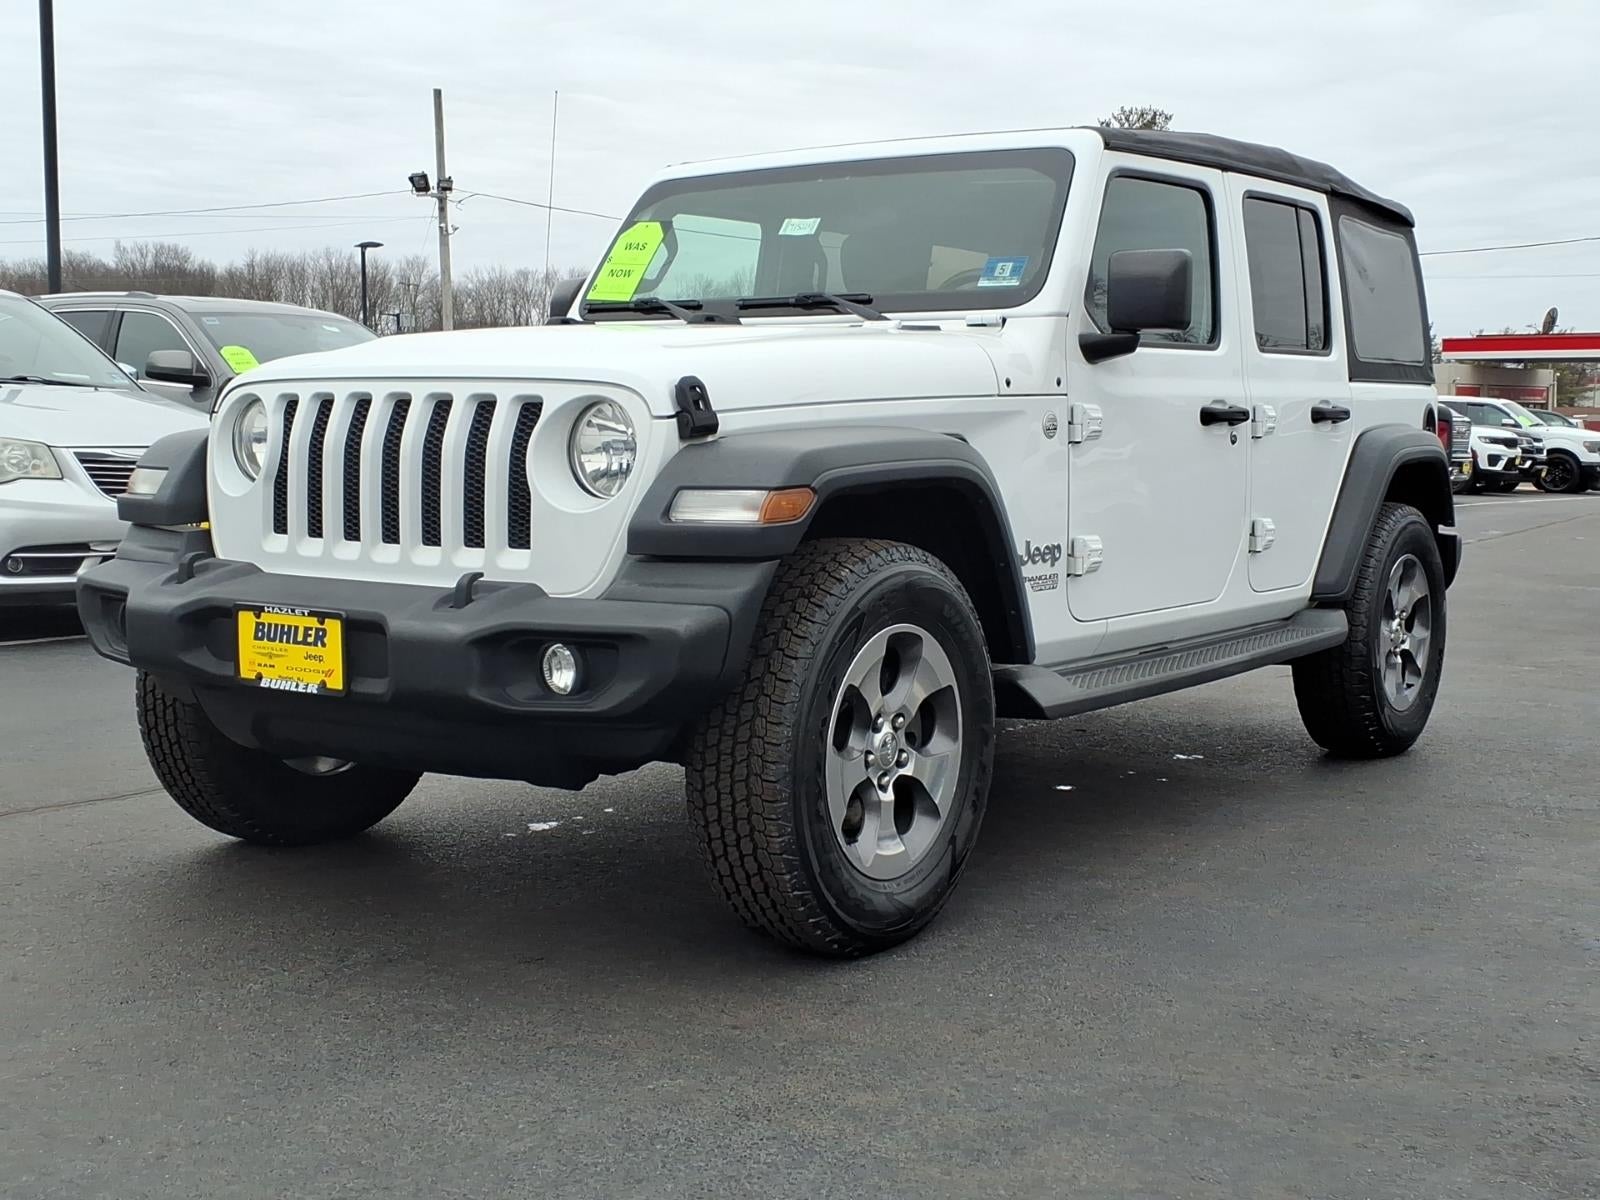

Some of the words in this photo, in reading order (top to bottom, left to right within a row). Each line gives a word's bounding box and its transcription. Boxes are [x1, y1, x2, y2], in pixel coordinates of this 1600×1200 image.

[624, 242, 648, 251] WAS
[607, 268, 634, 278] NOW
[999, 264, 1007, 275] 5
[1017, 539, 1062, 567] Jeep
[1023, 573, 1058, 583] RANGLER
[264, 606, 310, 616] HAZLET
[253, 621, 327, 648] BUHLER
[304, 651, 324, 663] Jeep
[260, 678, 318, 694] BUHLER
